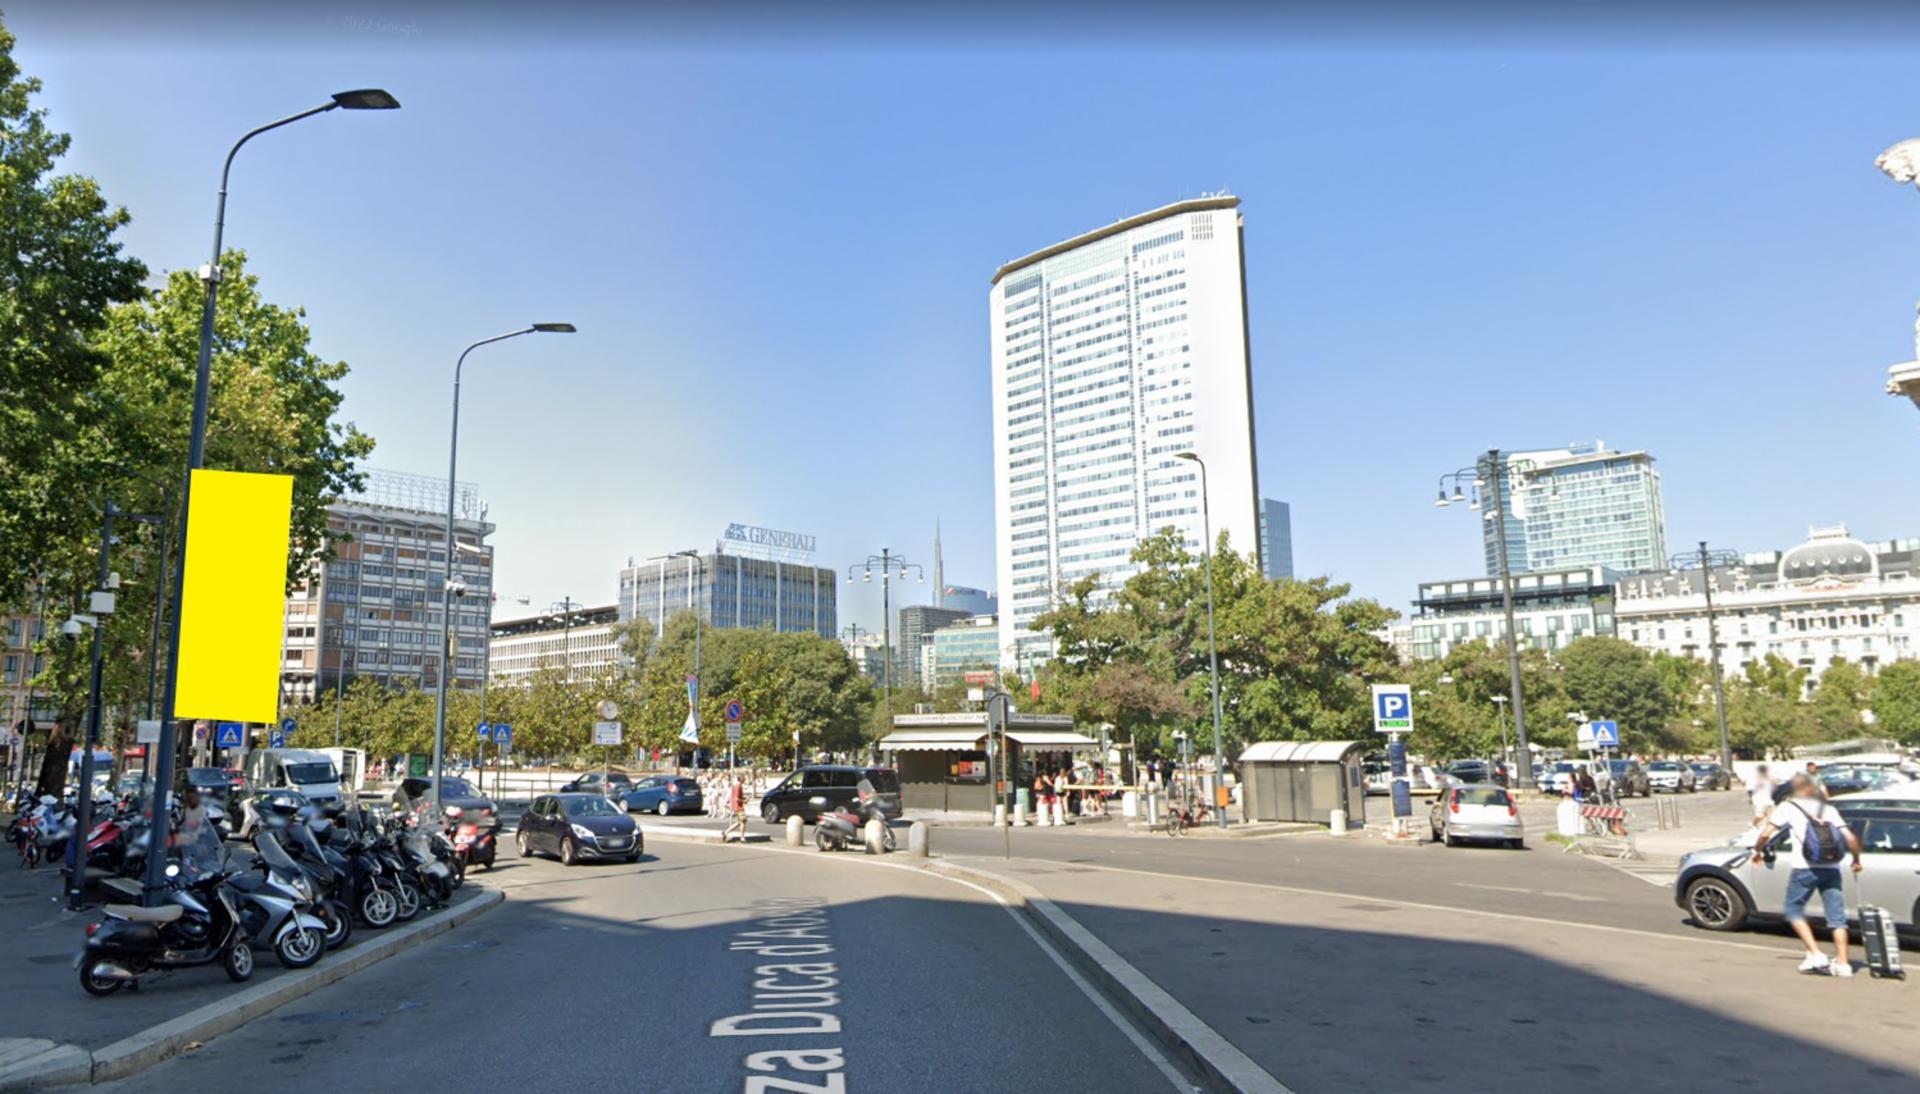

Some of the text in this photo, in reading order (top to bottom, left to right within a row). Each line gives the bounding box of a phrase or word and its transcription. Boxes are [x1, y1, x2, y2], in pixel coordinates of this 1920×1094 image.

[749, 526, 816, 552] GENERALI
[1384, 696, 1403, 717] P
[272, 731, 281, 742] P
